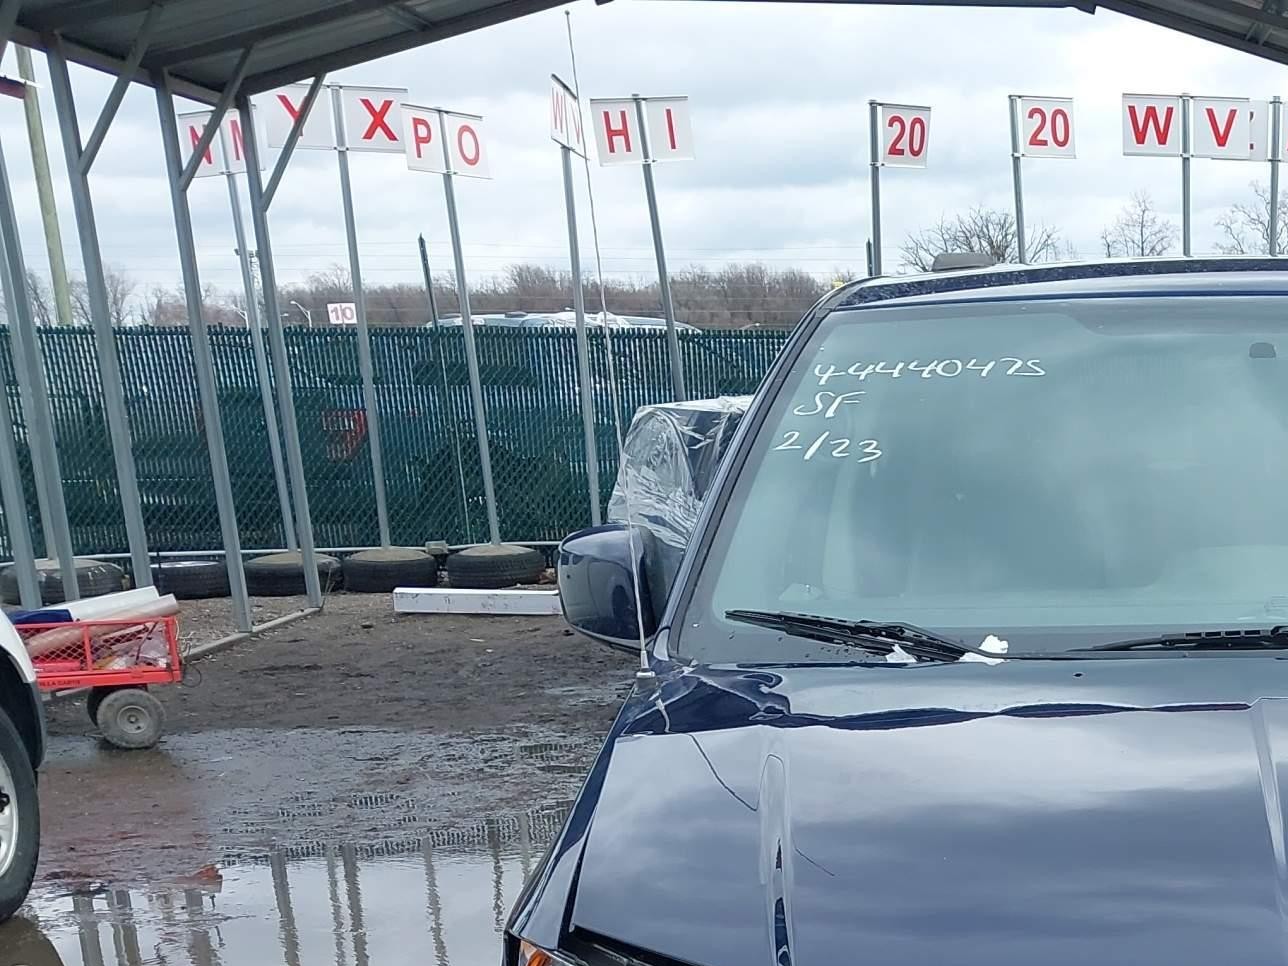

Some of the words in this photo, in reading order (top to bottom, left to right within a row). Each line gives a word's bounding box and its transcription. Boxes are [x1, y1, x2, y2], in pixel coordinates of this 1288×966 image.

[360, 98, 399, 141] X
[412, 117, 432, 159] P
[603, 110, 632, 154] H
[665, 108, 677, 150] I
[887, 114, 926, 157] 20
[1027, 107, 1070, 148] 20
[1128, 104, 1174, 146] W
[1205, 107, 1238, 147] V
[814, 357, 1046, 386] 44440475
[775, 431, 882, 463] 2/23
